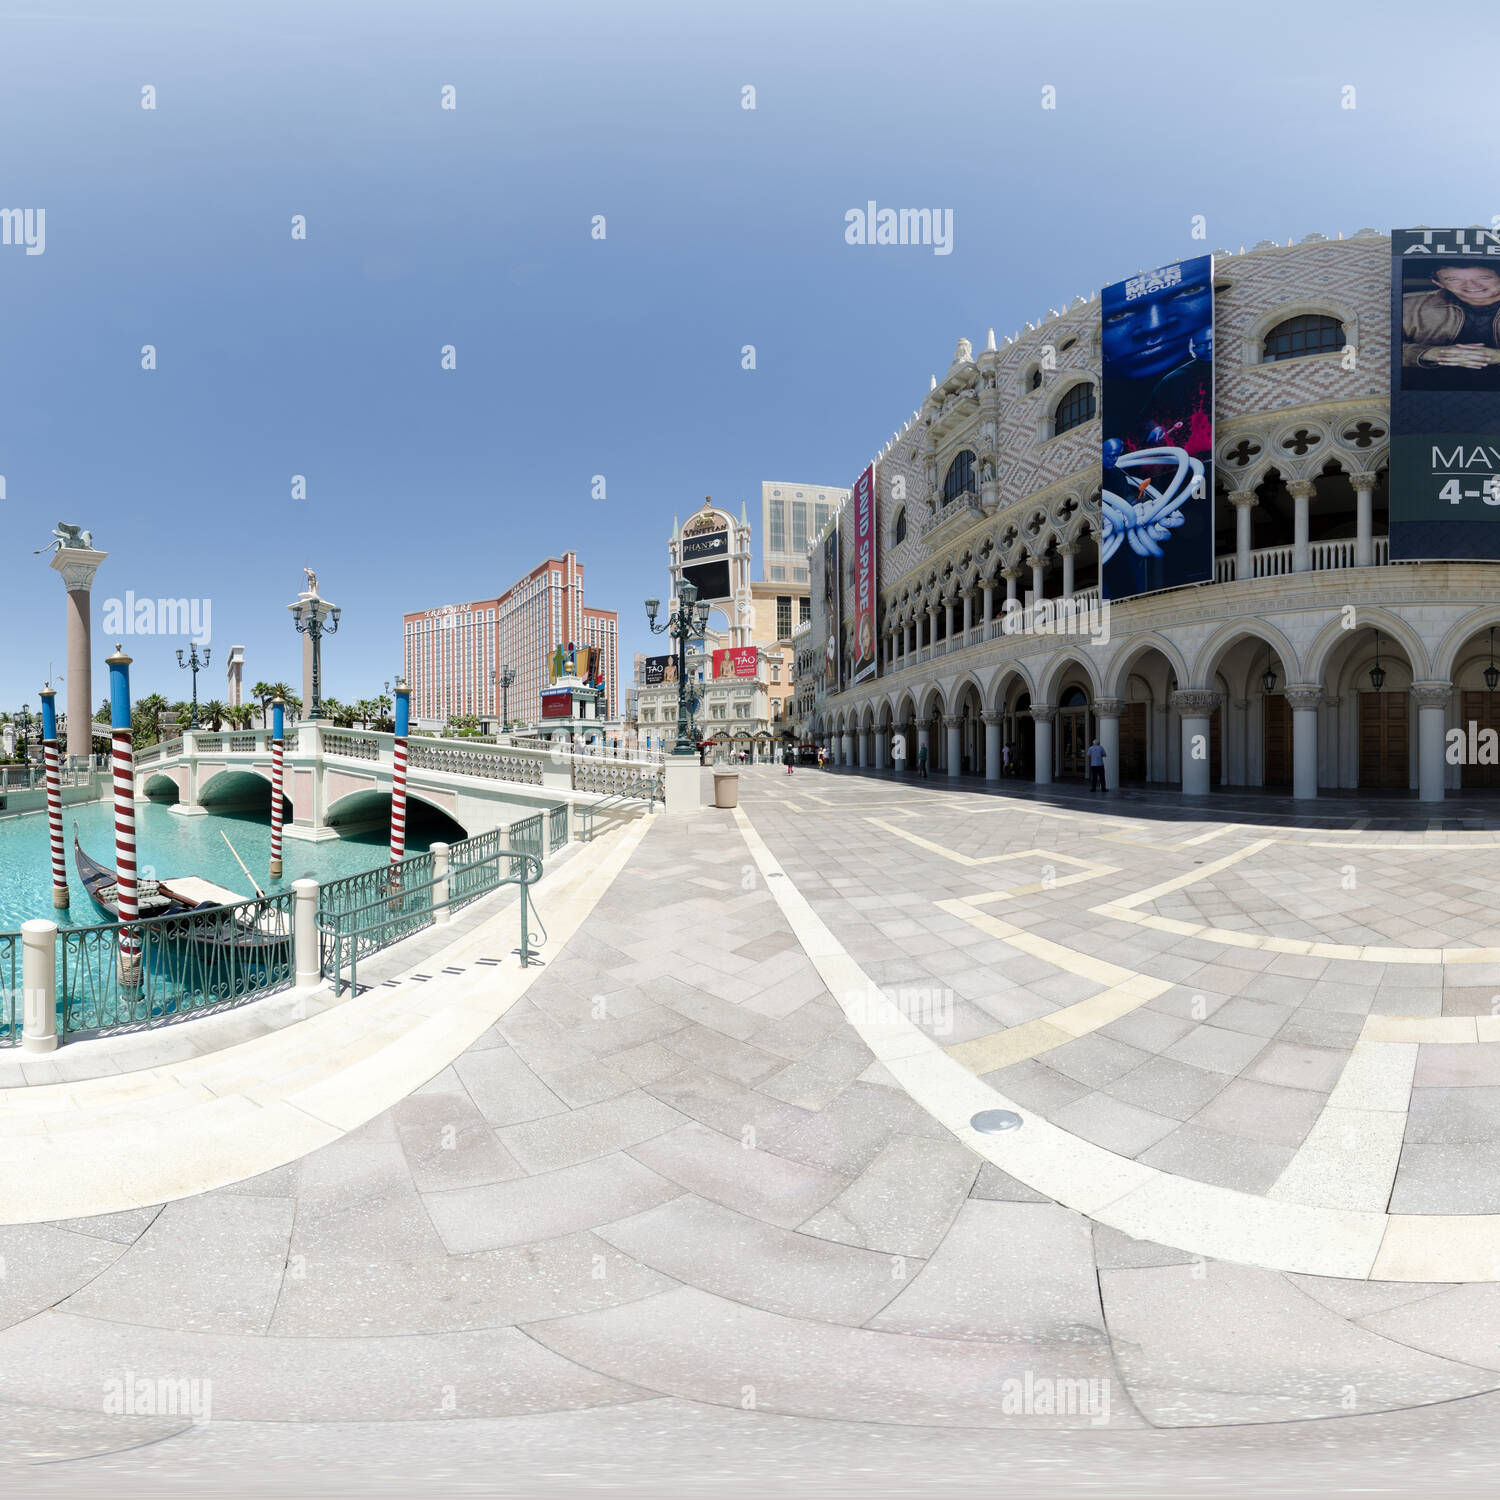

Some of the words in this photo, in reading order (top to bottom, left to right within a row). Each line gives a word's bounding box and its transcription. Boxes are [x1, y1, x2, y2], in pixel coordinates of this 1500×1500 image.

[1125, 265, 1181, 288] BLUE
[1125, 271, 1182, 296] MAN
[1126, 279, 1182, 301] GROUP
[859, 475, 869, 536] DAVID
[859, 539, 870, 613] SPADE
[647, 665, 663, 673] TAO
[735, 656, 755, 664] TAO
